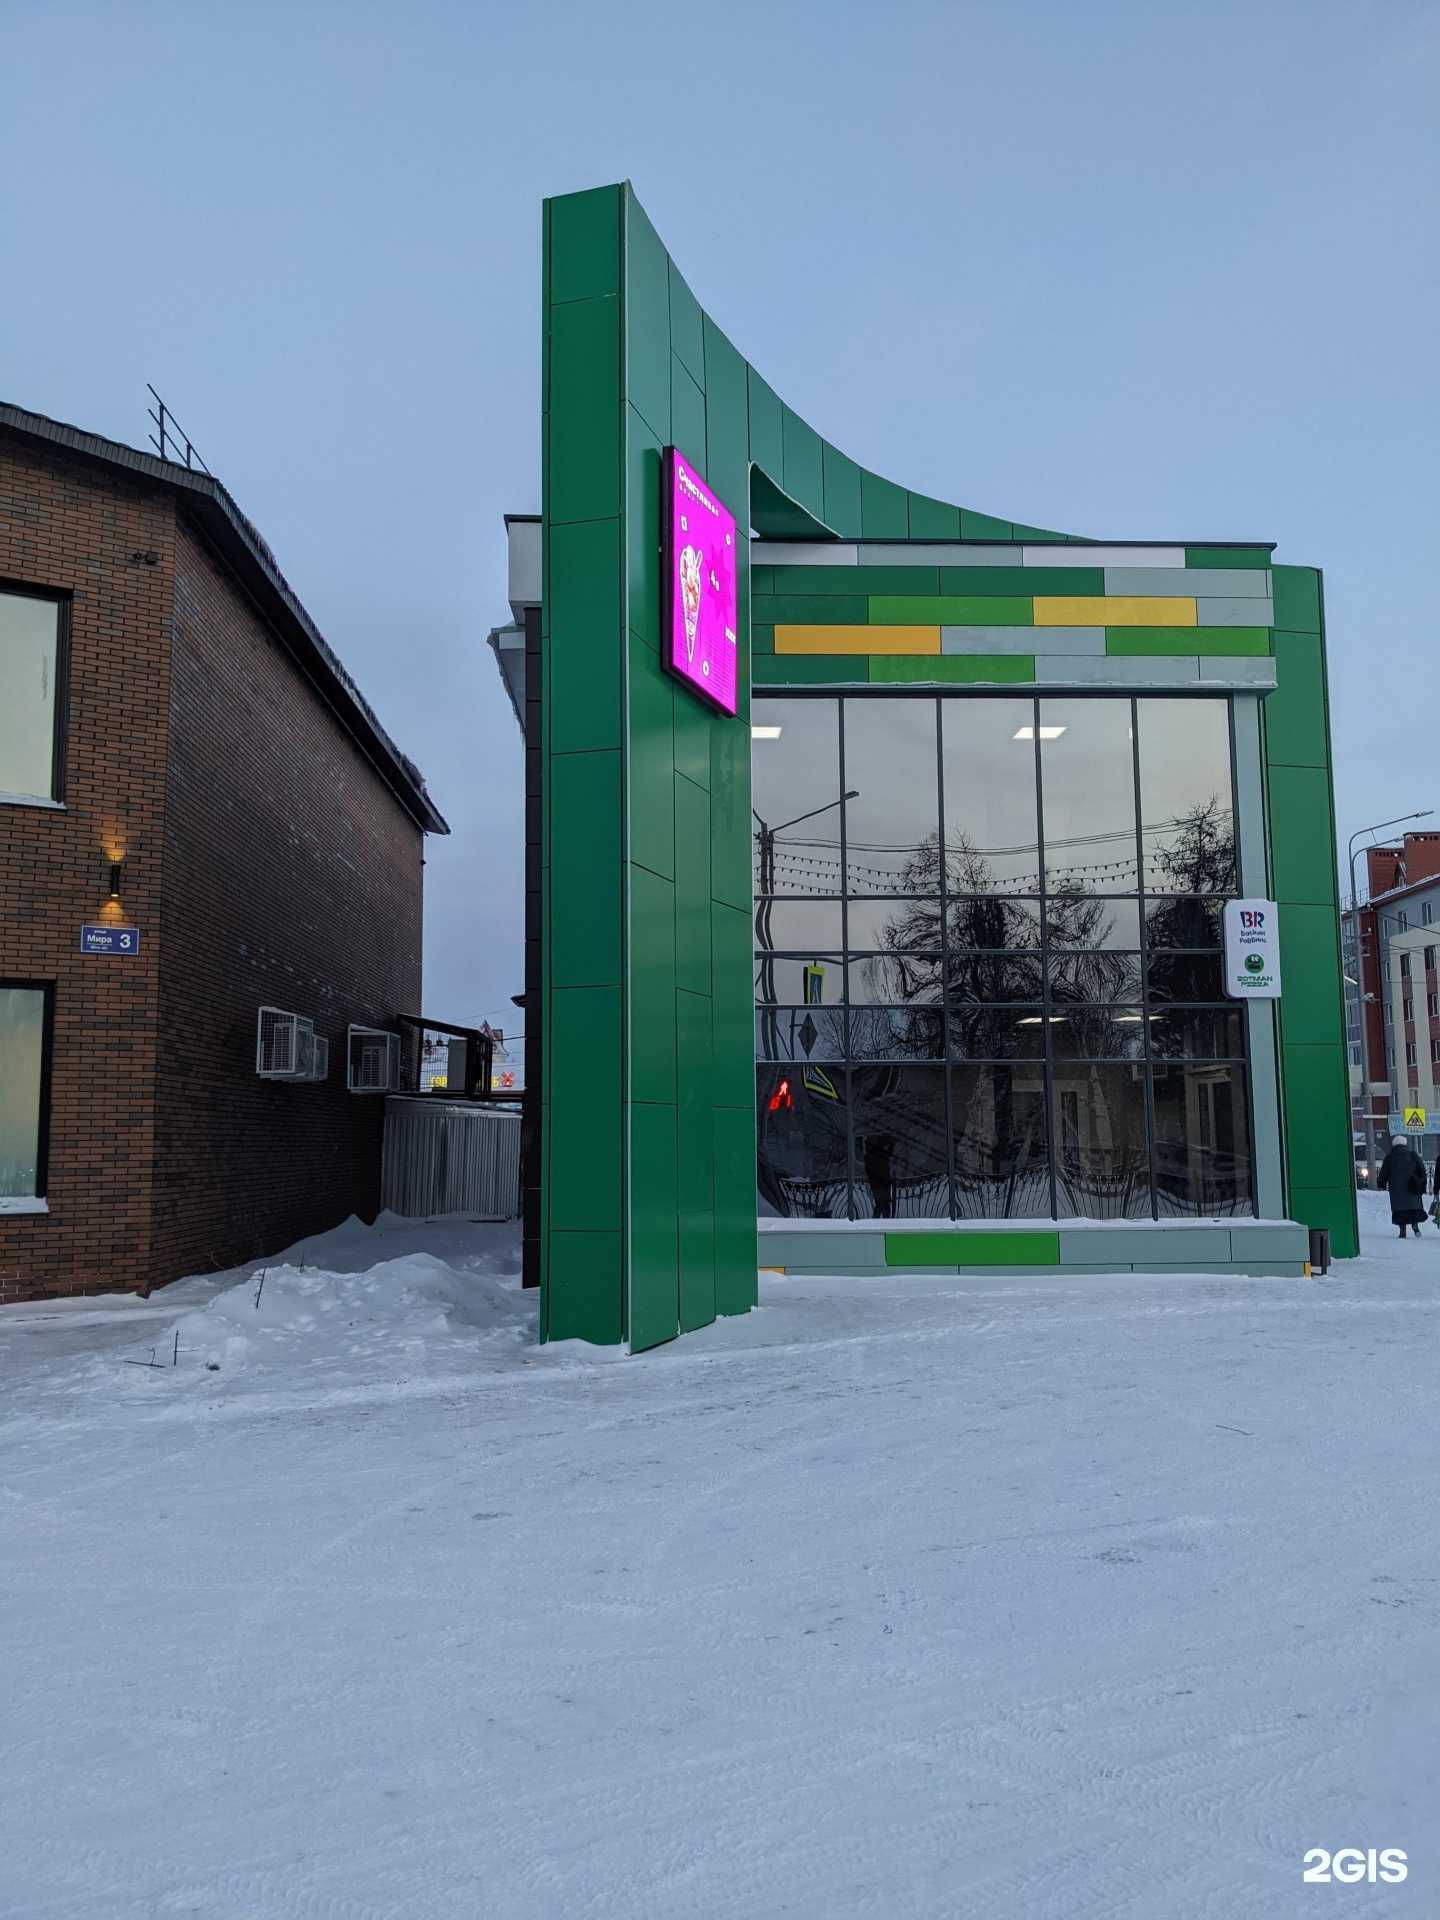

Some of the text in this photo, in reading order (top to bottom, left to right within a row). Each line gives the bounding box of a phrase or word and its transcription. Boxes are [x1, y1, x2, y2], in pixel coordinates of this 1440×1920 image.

[1240, 911, 1265, 928] BR
[87, 934, 131, 949] Мира 3
